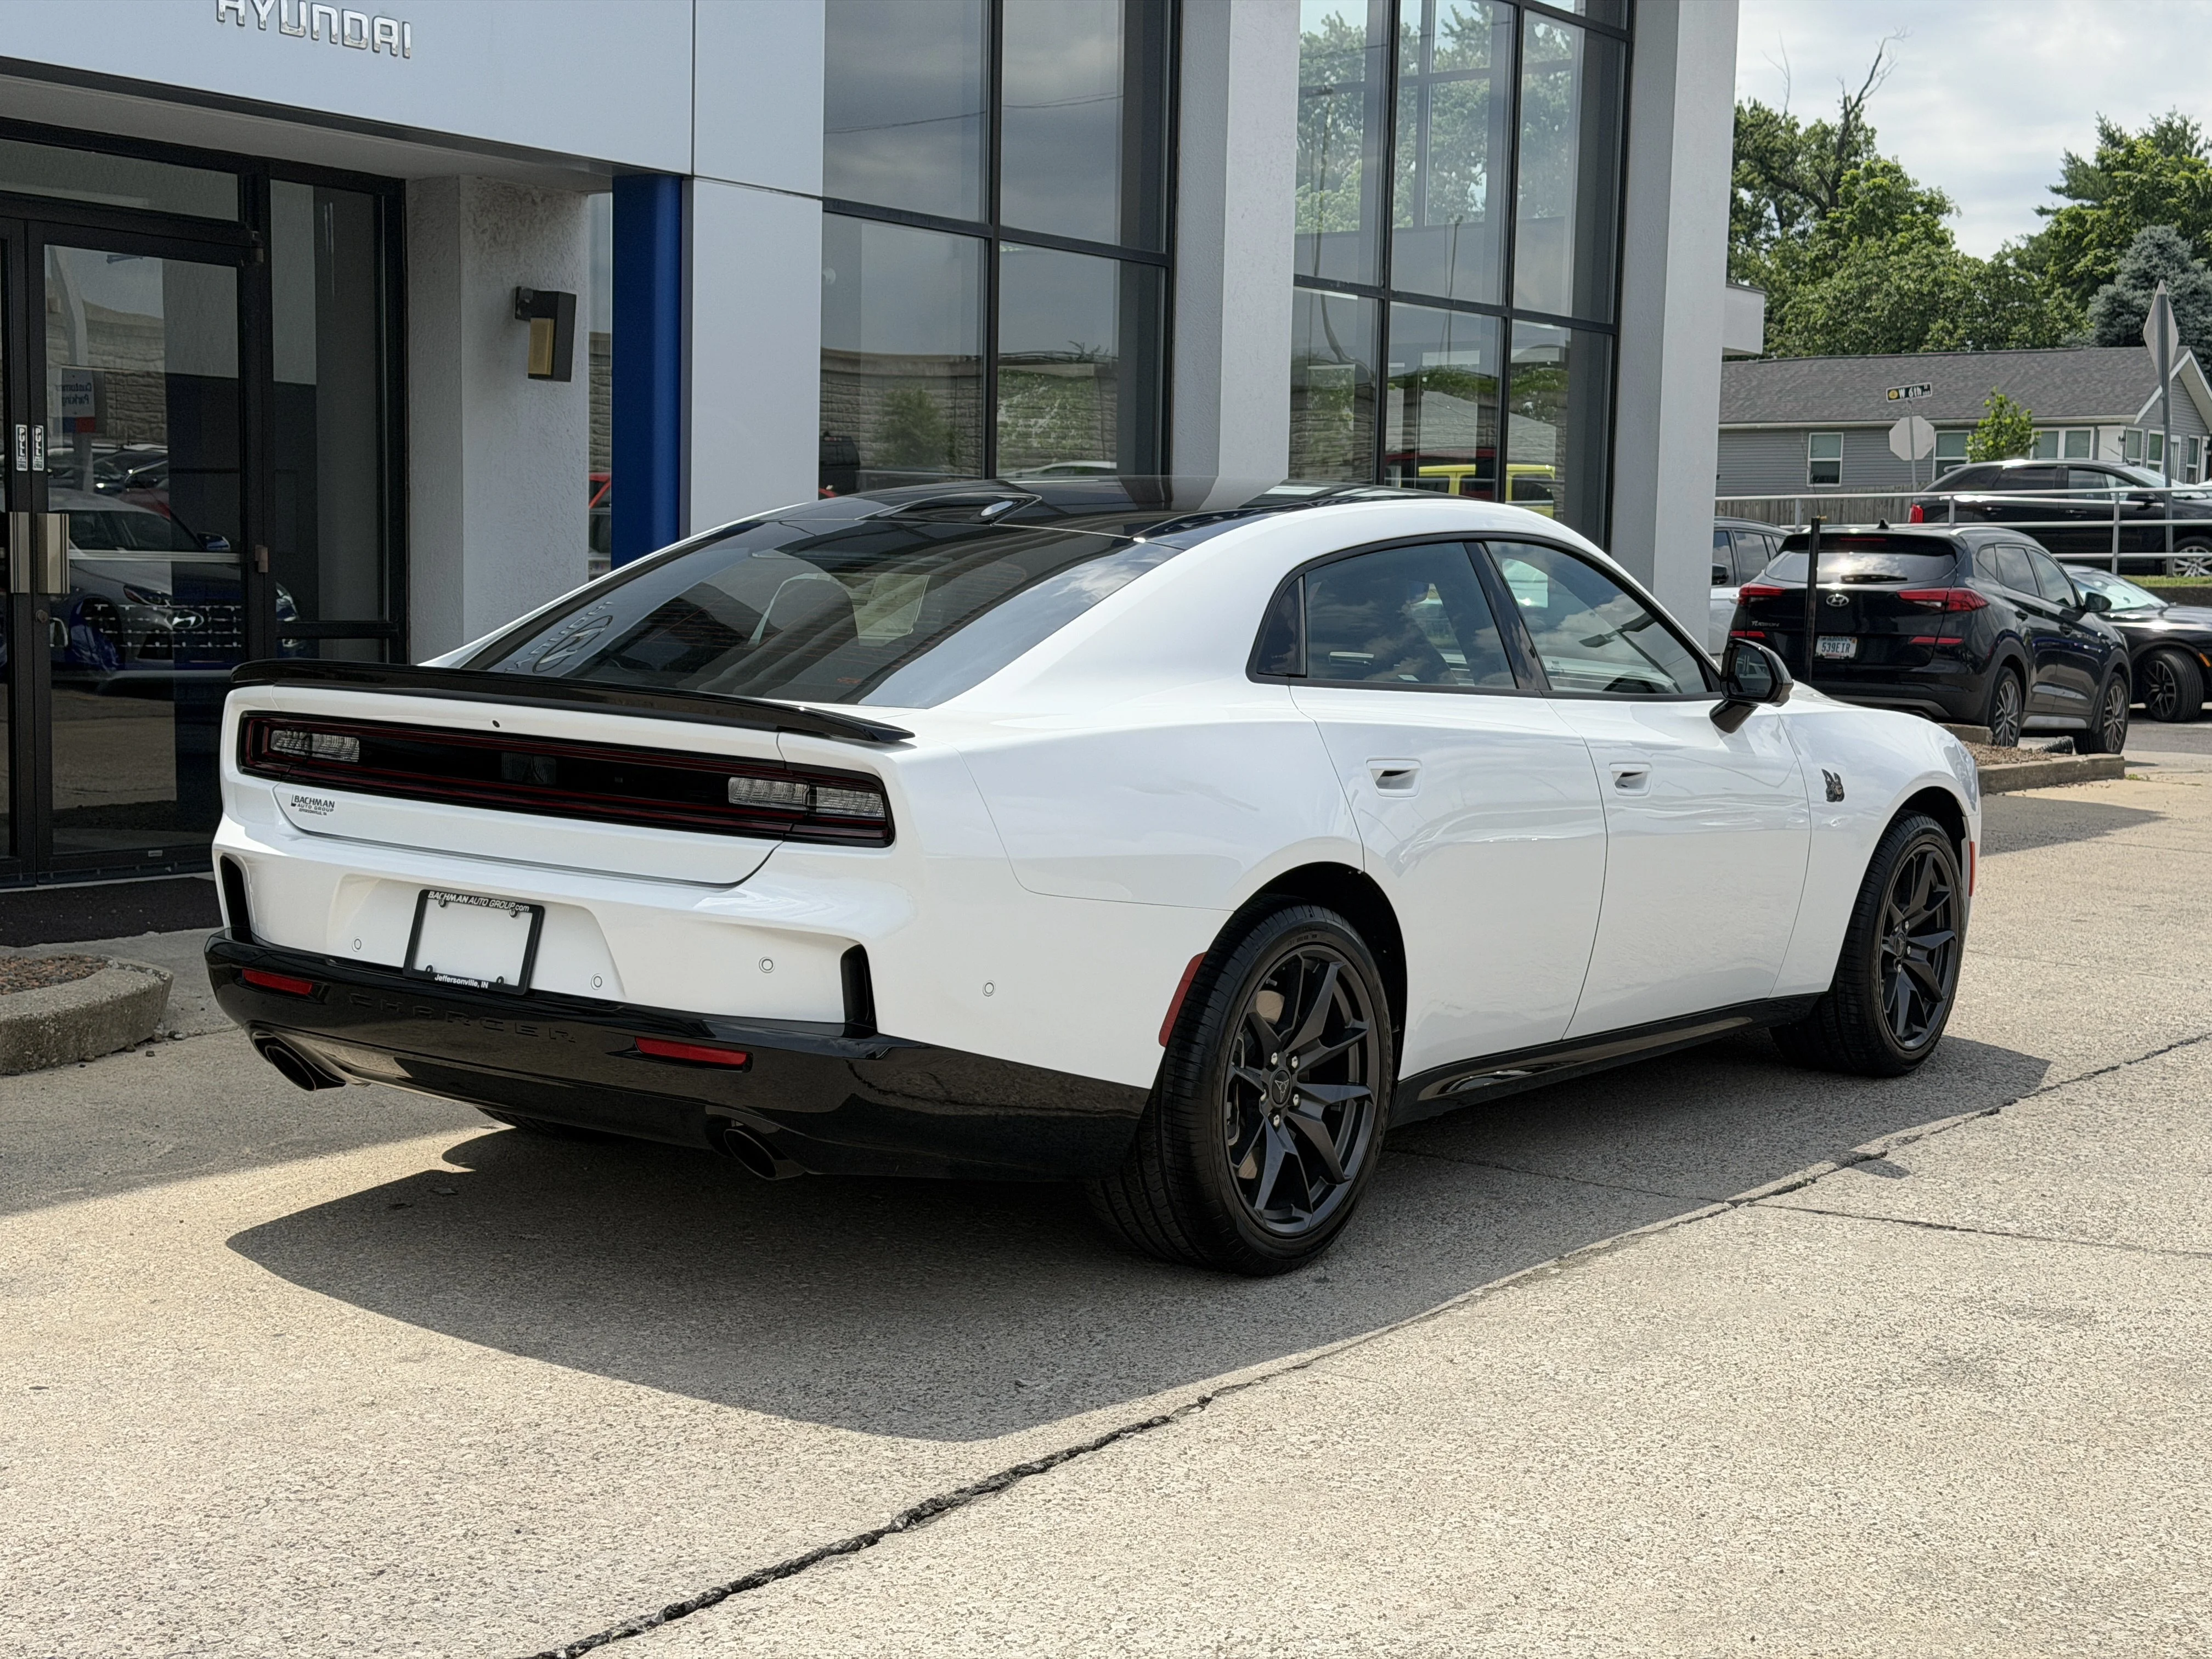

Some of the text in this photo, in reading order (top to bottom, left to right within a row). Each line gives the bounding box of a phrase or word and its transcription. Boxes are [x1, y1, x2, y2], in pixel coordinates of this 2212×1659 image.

[217, 0, 411, 59] HYUNDAI
[1899, 386, 1922, 399] W 6th
[1821, 642, 1850, 653] 539EIR
[295, 795, 335, 808] BACHMAN
[428, 891, 468, 904] BACHMAN
[468, 898, 488, 906] AUTO
[435, 974, 479, 988] Jeffersonville,
[348, 992, 576, 1043] CHARGER
